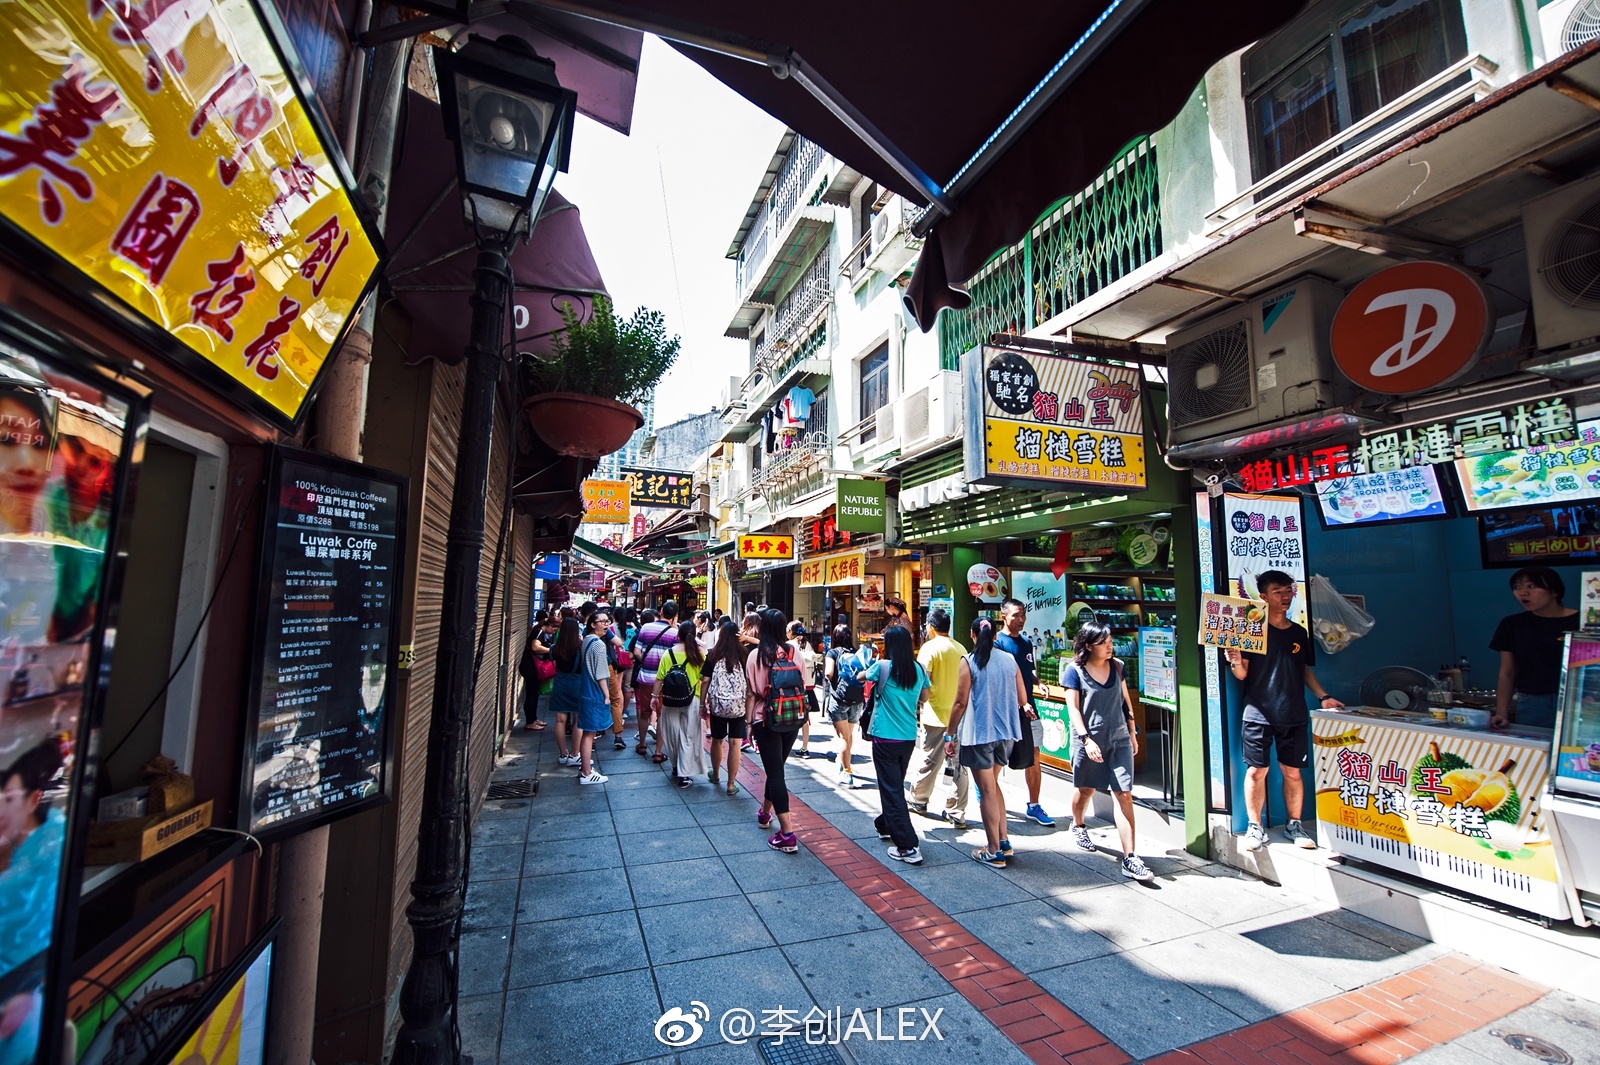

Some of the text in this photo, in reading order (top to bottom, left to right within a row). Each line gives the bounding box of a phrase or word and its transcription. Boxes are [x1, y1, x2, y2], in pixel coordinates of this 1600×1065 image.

[1262, 288, 1296, 308] DAIKIN
[989, 369, 1034, 387] 獨家首創
[995, 382, 1029, 403] 馳名
[1032, 389, 1114, 425] 貓山王
[1356, 397, 1574, 476] 榴槤雪糕
[1015, 427, 1126, 467] 榴槤雪糕
[1239, 444, 1352, 492] 貓山王
[295, 480, 318, 491] 100%
[1355, 482, 1426, 496] FROZEN YOGURT
[844, 495, 879, 506] NATURE
[841, 506, 883, 517] REPUBLIC
[1249, 511, 1299, 533] 貓山王
[299, 532, 377, 550] Luwak Coffe
[1230, 535, 1302, 559] 榴槤雪糕
[305, 546, 372, 561] 貓屎咖啡系列
[830, 557, 859, 582] 大特價
[1026, 587, 1047, 600] FEEL
[1034, 596, 1063, 610] NATURE
[1206, 600, 1246, 618] 貓山王
[1204, 616, 1263, 637] 榴槤雪糕
[301, 637, 331, 649] Americano
[300, 661, 332, 672] Cappuccino
[276, 684, 331, 699] Luwak Latte Coffee
[320, 726, 347, 738] Macchiato
[1337, 748, 1452, 795] 貓山王
[1339, 779, 1492, 840] 榴槤雪糕
[157, 810, 202, 842] GOURMET
[1360, 813, 1406, 834] Durian
